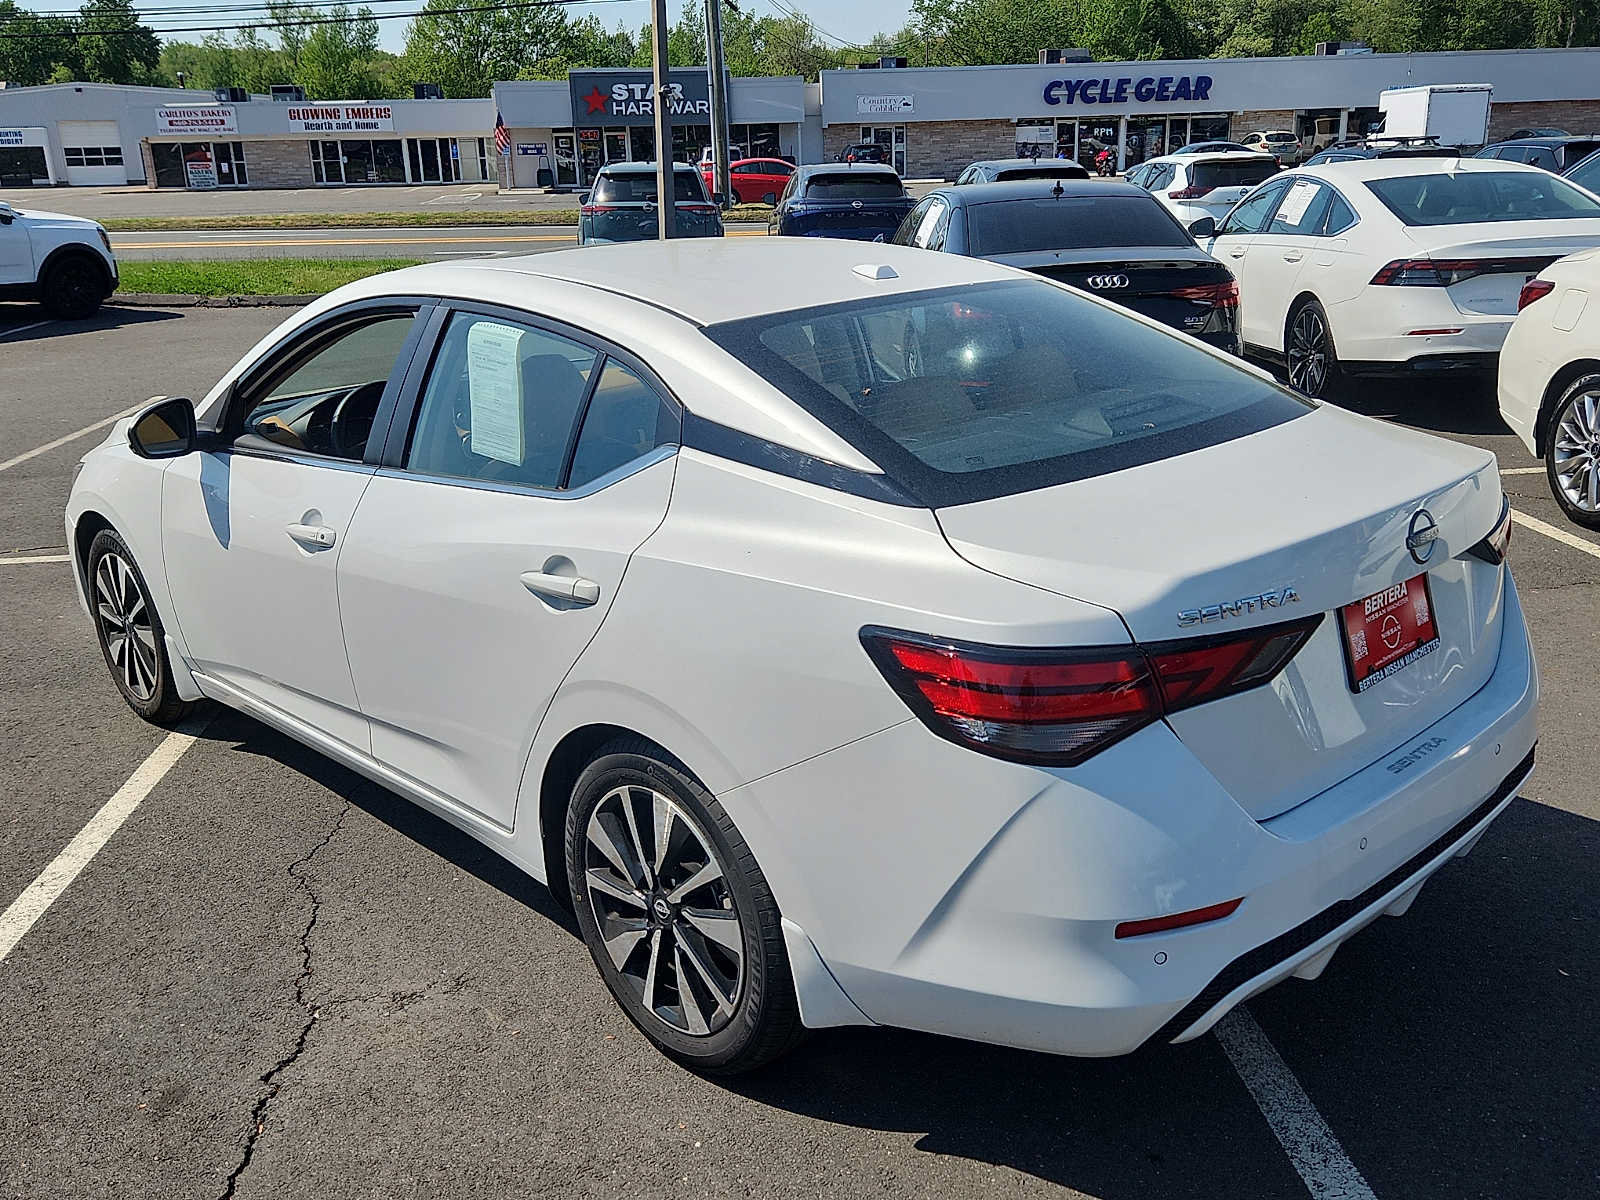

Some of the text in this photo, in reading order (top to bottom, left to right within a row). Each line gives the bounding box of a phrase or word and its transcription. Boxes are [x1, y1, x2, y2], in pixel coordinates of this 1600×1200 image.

[1043, 76, 1213, 105] CYCLE GEAR
[158, 108, 232, 118] CARLITO'S BAKERY
[288, 106, 391, 120] GLOWING EMBERS
[612, 100, 710, 115] HARWAR
[304, 120, 380, 131] Hearth and Home
[1094, 127, 1113, 137] RPM
[1364, 581, 1408, 616] BERTERA
[1177, 587, 1300, 628] SENTRA
[1381, 623, 1402, 640] NISSAN
[1359, 637, 1441, 692] BERTERA NISSAN MANCHESTER
[1386, 737, 1448, 774] SENTRA
